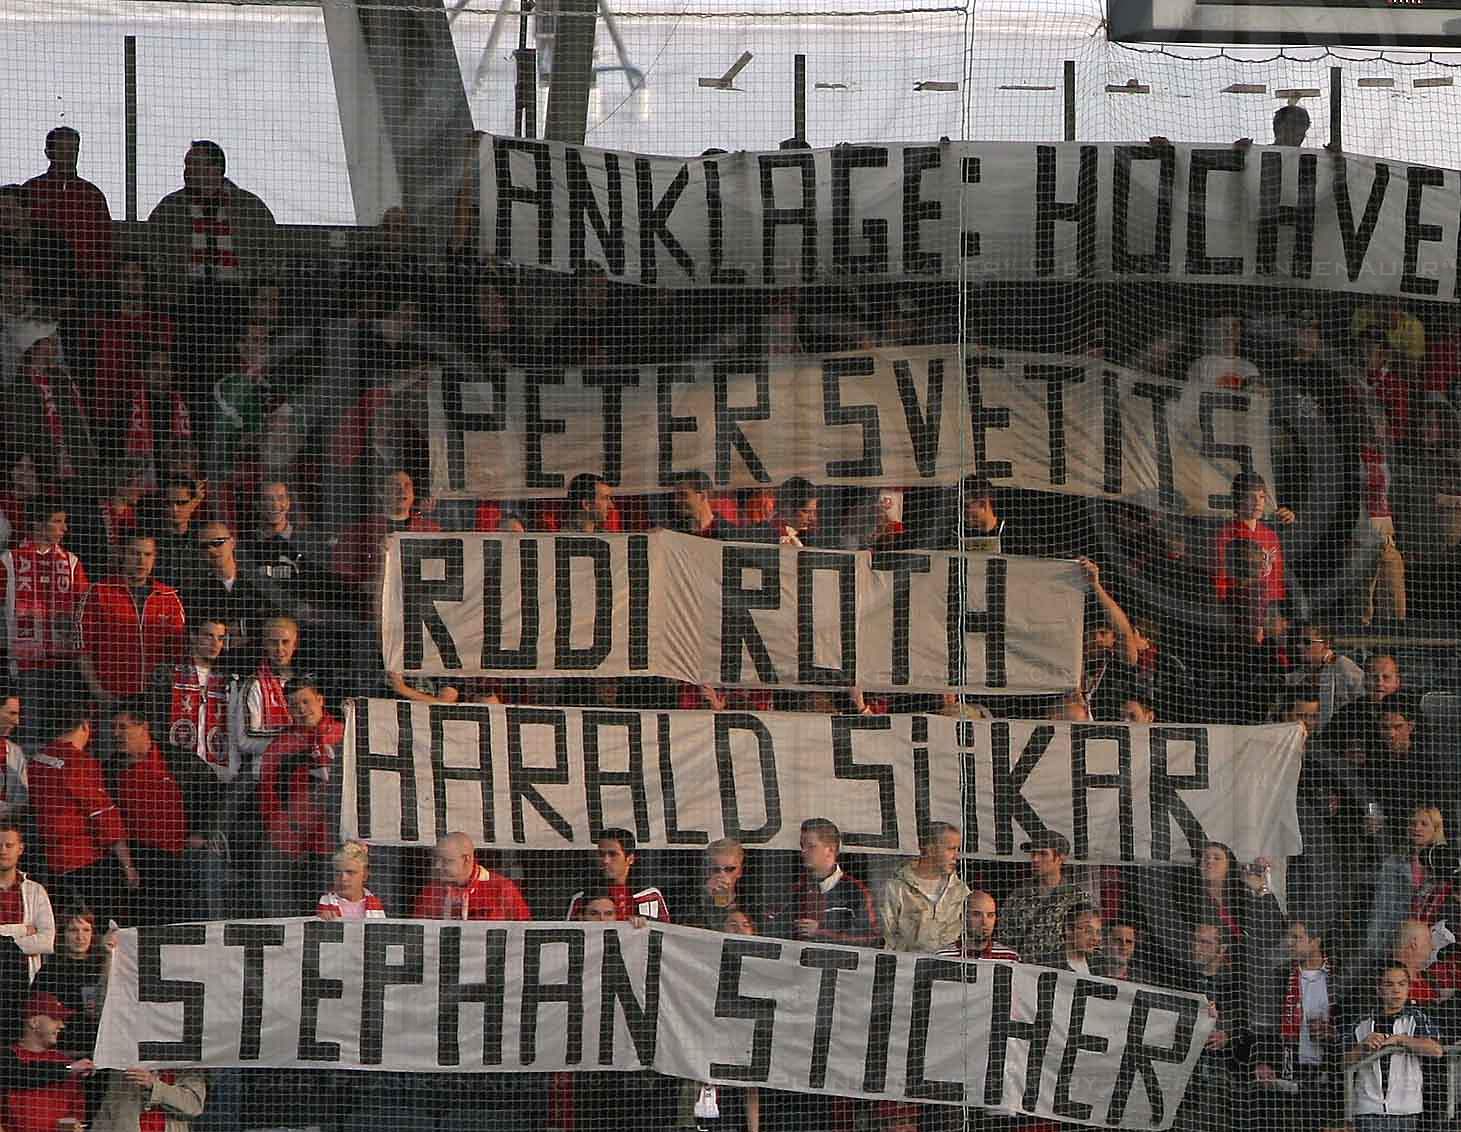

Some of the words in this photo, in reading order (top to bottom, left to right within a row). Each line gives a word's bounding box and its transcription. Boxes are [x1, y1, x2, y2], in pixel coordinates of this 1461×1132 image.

[493, 135, 981, 286] ANKLAGE:
[440, 360, 775, 490] PETER
[822, 347, 1255, 512] SVETITS
[399, 534, 650, 672] RUDI
[720, 544, 1008, 690] ROTH
[354, 703, 784, 845] HARALD
[137, 923, 662, 1067] STEPHAN
[710, 939, 1198, 1128] STICHER
